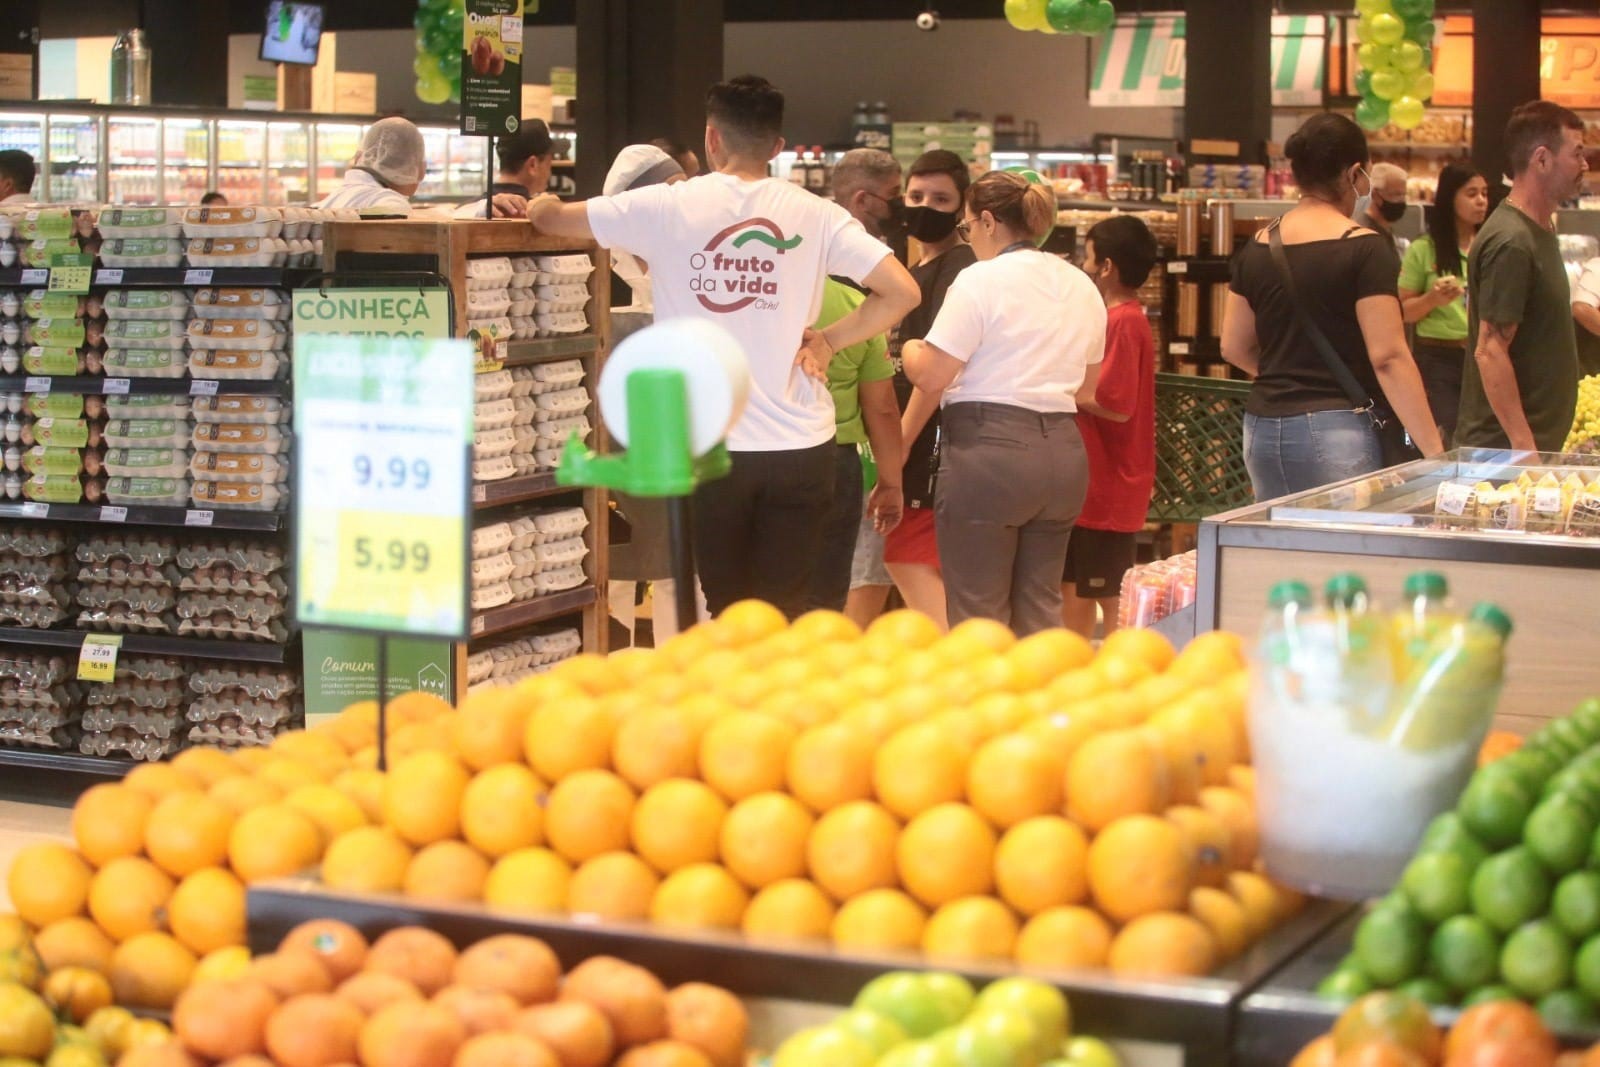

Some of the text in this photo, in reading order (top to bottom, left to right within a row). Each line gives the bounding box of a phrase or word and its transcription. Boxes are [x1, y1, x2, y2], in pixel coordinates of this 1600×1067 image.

[689, 252, 775, 273] O fruto
[689, 272, 778, 295] da vida
[296, 299, 430, 325] CONHEÇA
[353, 454, 431, 490] 9,99
[353, 536, 431, 573] 5,99
[320, 656, 376, 674] Comum
